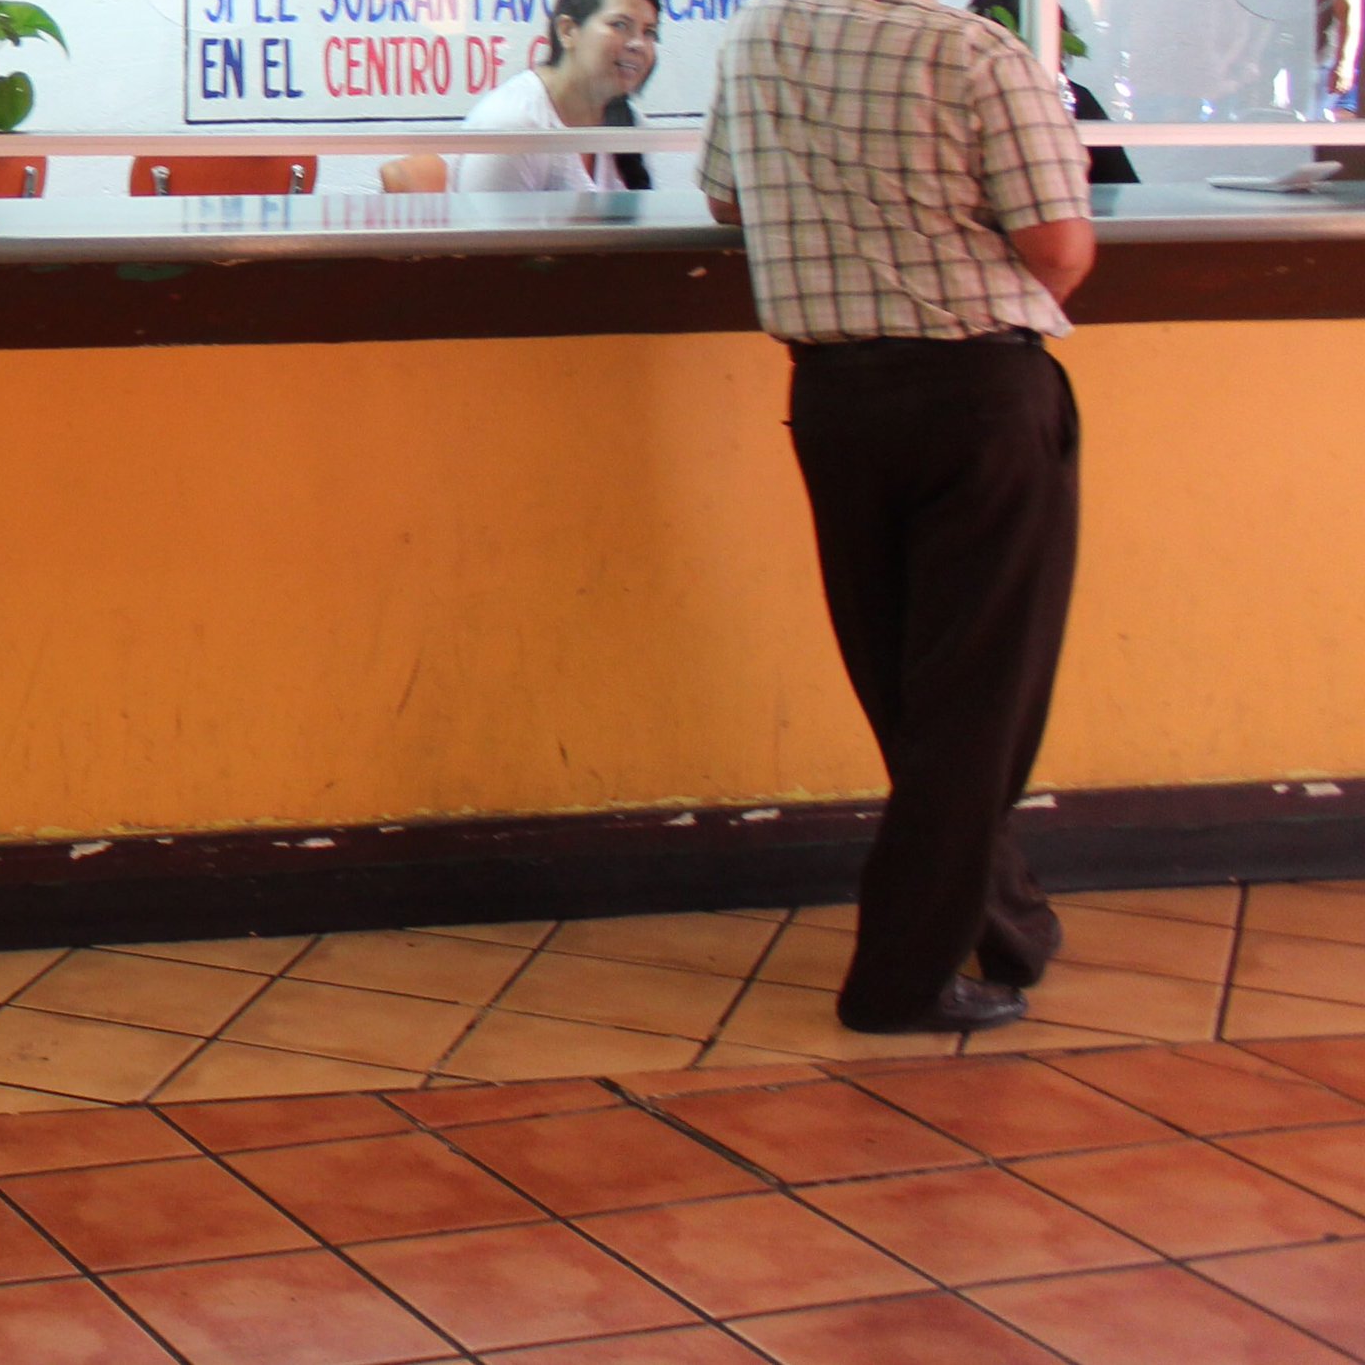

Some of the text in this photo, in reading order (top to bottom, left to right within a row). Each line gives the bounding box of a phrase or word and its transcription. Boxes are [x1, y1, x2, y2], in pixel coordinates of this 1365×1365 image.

[201, 36, 245, 99] EN
[262, 37, 305, 99] EL
[323, 36, 453, 98] CENTRO
[465, 36, 507, 96] DE
